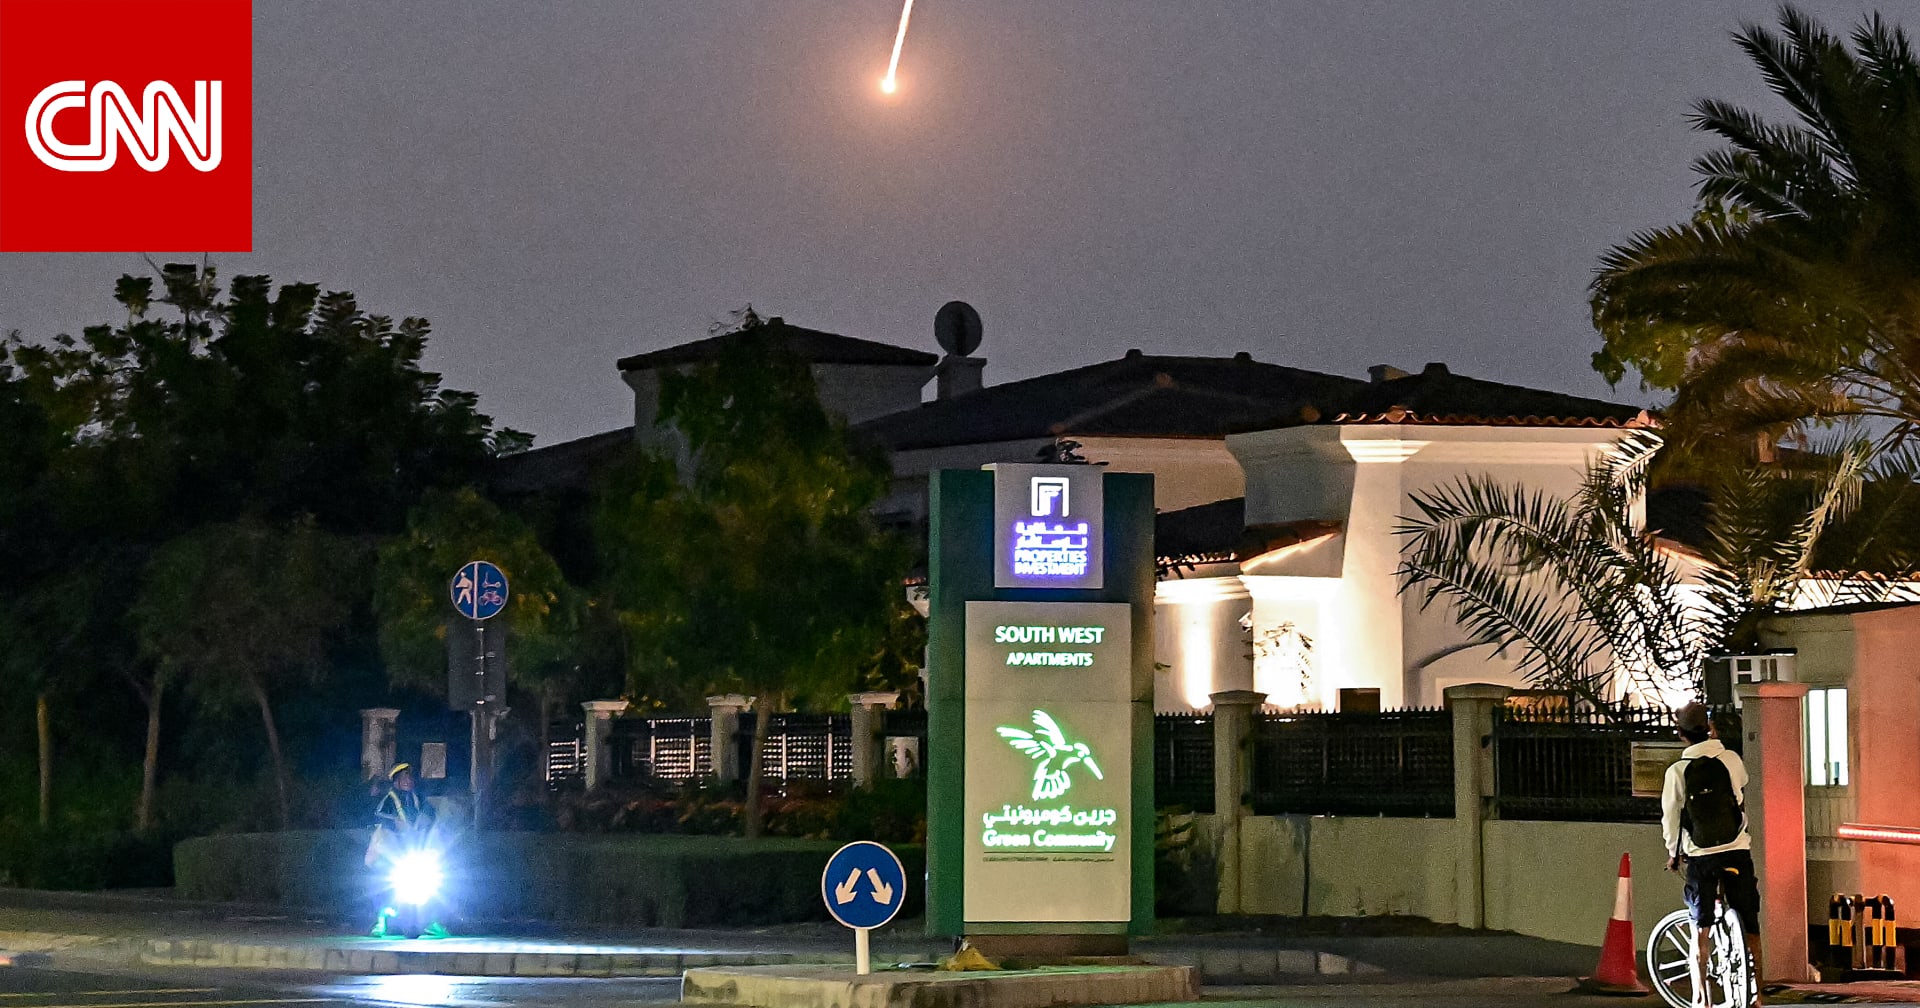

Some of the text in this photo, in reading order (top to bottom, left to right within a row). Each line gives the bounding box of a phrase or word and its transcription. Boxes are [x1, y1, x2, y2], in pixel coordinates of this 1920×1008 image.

[1015, 549, 1088, 562] PROPERTIES
[1015, 562, 1088, 575] INVESTMENT
[994, 625, 1105, 644] SOUTH WEST
[1006, 652, 1093, 666] APARTMENTS
[1073, 808, 1117, 826] جرين
[982, 829, 1116, 851] Green Community
